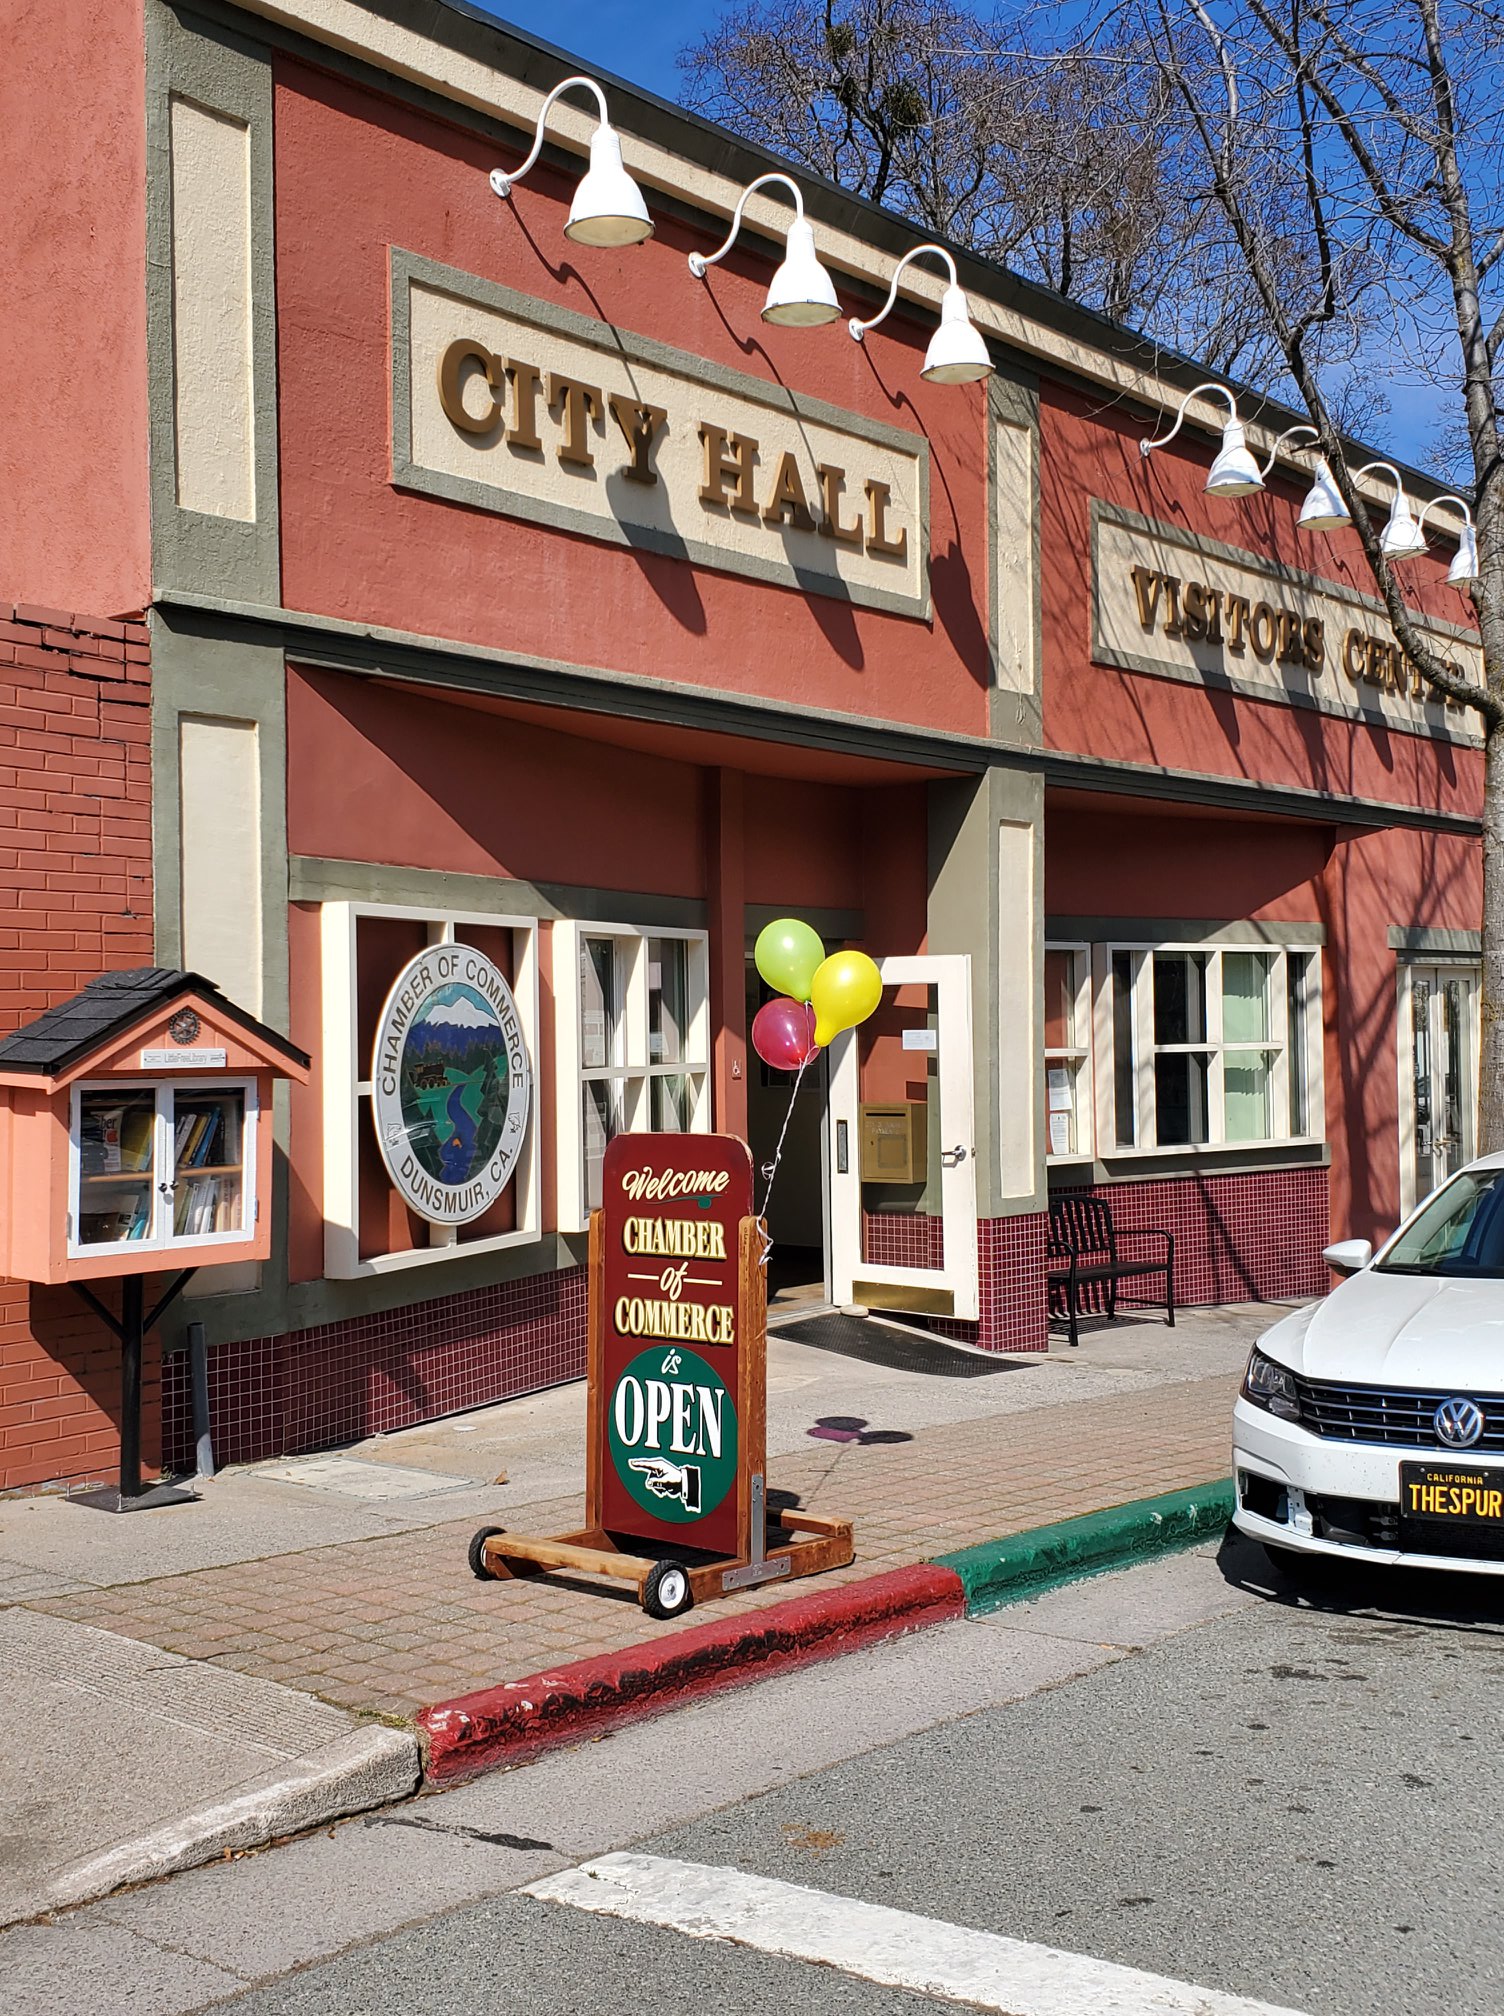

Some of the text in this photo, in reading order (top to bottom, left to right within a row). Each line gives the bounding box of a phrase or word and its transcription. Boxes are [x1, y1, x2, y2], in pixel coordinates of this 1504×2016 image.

[437, 339, 907, 556] CITY HALL
[1130, 564, 1325, 671] VISITORS
[382, 954, 524, 1097] CHAMBER OF COMMERCE
[400, 1147, 513, 1214] DUNSMUIR, CA.
[622, 1166, 730, 1200] Welcome
[622, 1215, 728, 1260] CHAMBER
[660, 1261, 689, 1301] of
[614, 1296, 735, 1345] COMMERCE
[661, 1348, 682, 1375] is
[614, 1375, 726, 1458] OPEN
[1408, 1484, 1502, 1518] THESPUR
[1426, 1472, 1484, 1486] CALIFORNIA
